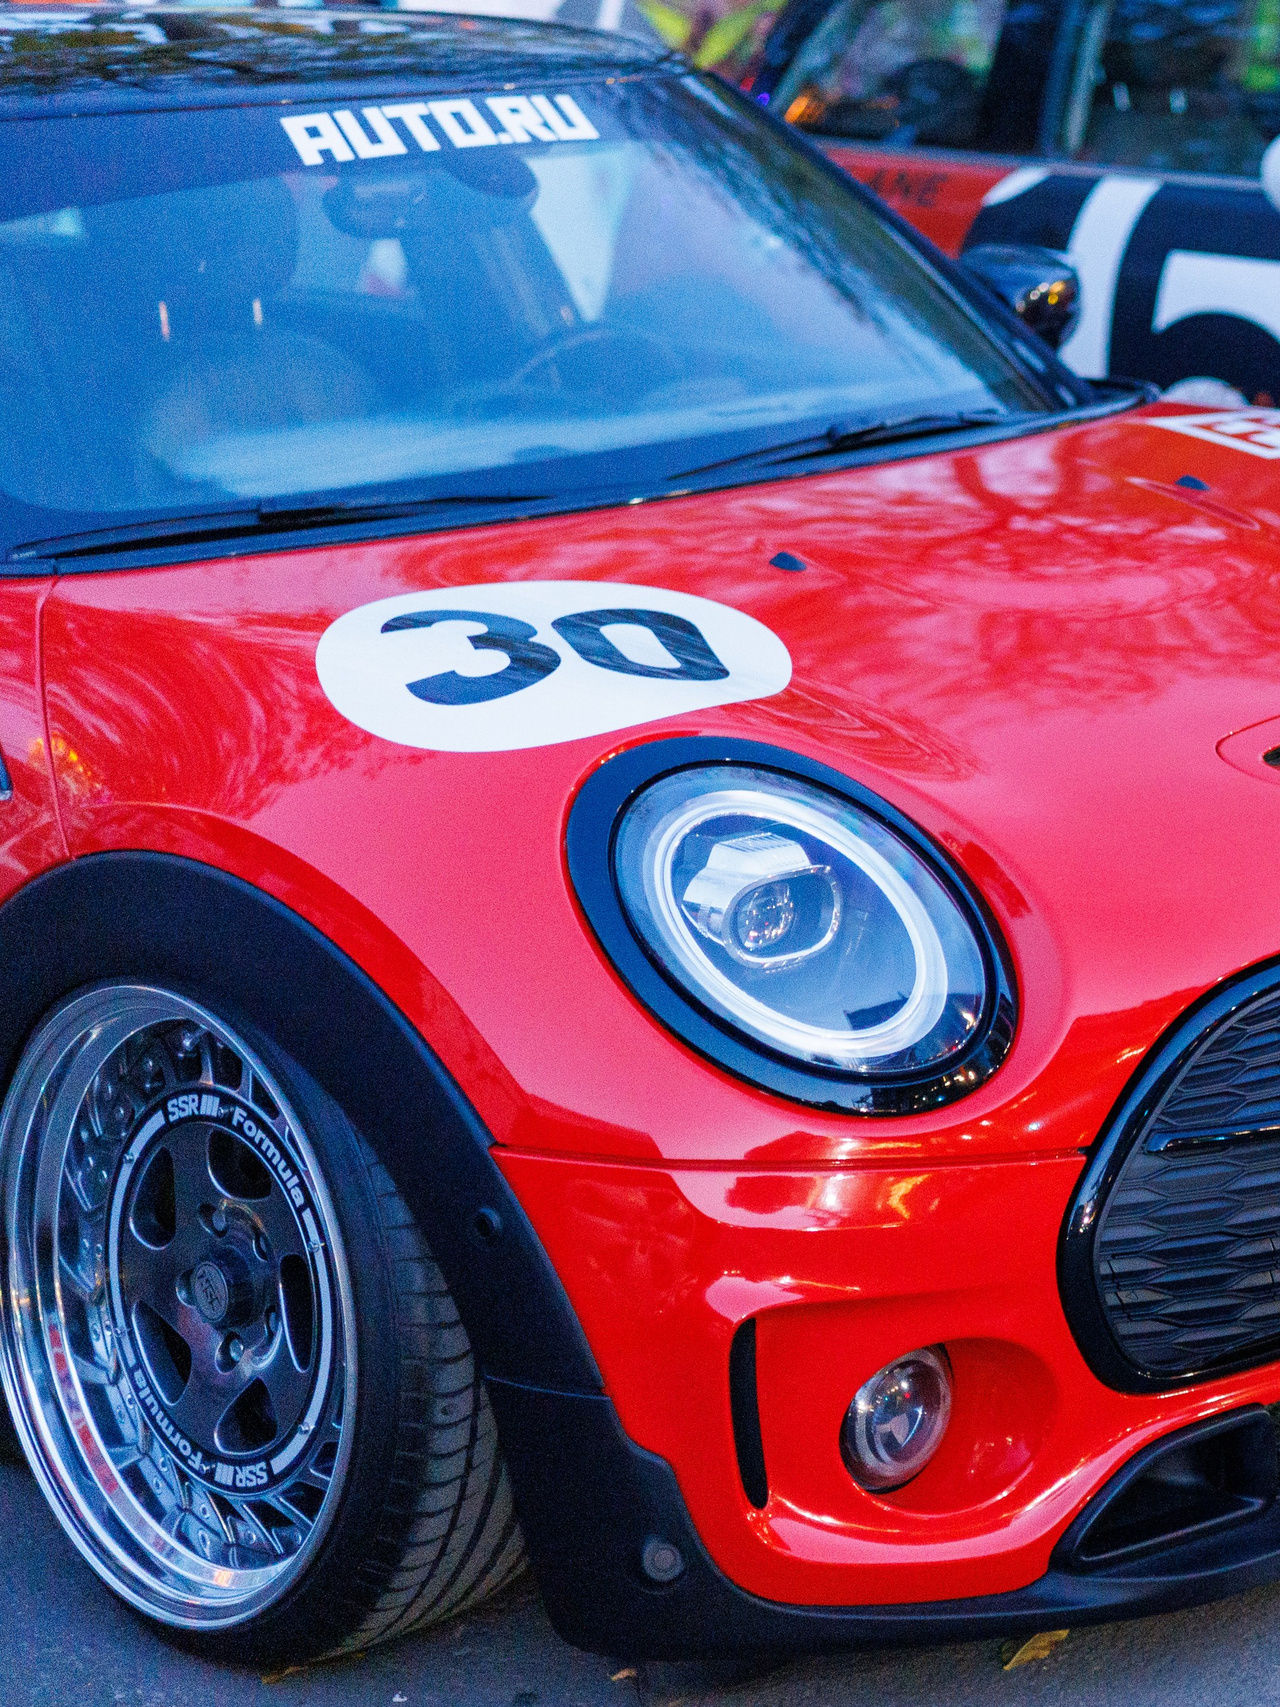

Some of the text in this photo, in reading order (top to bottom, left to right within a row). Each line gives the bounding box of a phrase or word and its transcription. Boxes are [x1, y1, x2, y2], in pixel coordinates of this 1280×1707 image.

[280, 94, 600, 166] AUTO.RU
[380, 607, 731, 706] 30
[231, 1105, 306, 1208] Formula
[133, 1368, 203, 1471] Formula
